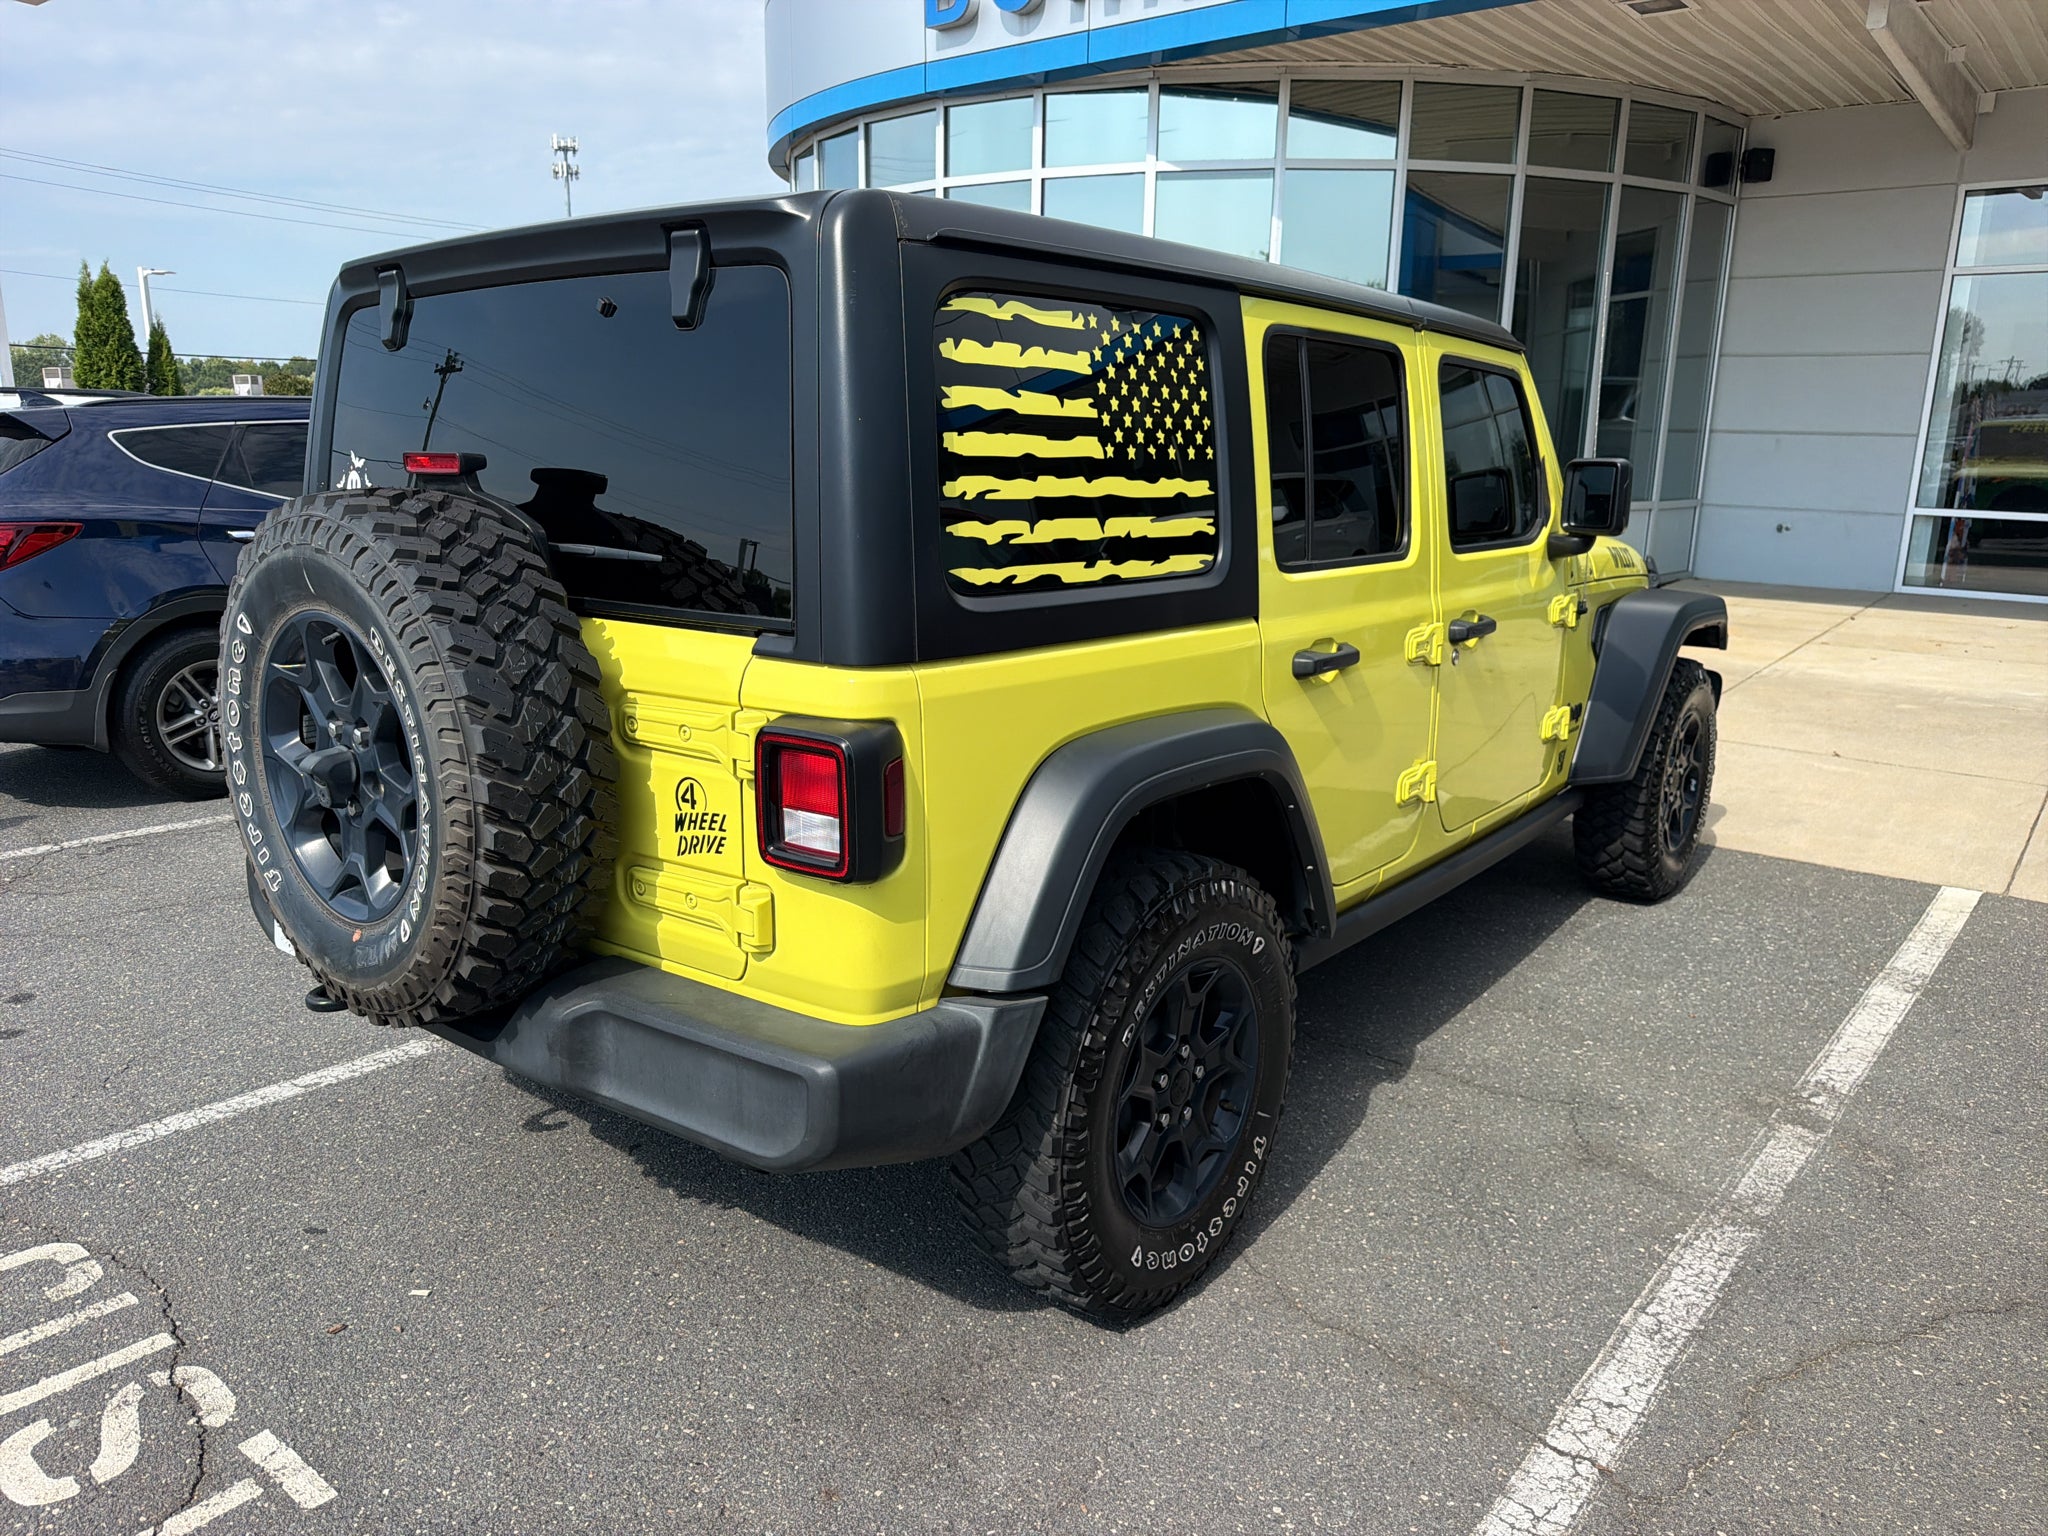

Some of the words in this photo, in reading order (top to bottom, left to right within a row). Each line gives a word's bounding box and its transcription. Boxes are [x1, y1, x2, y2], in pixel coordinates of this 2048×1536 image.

[225, 638, 283, 891] Firestone
[370, 625, 432, 922] DESTINATION
[675, 812, 727, 833] WHEEL
[680, 782, 697, 810] 4
[677, 834, 727, 856] DRIVE
[1121, 922, 1255, 1049] DESTINATION
[1146, 1135, 1268, 1271] Firestone
